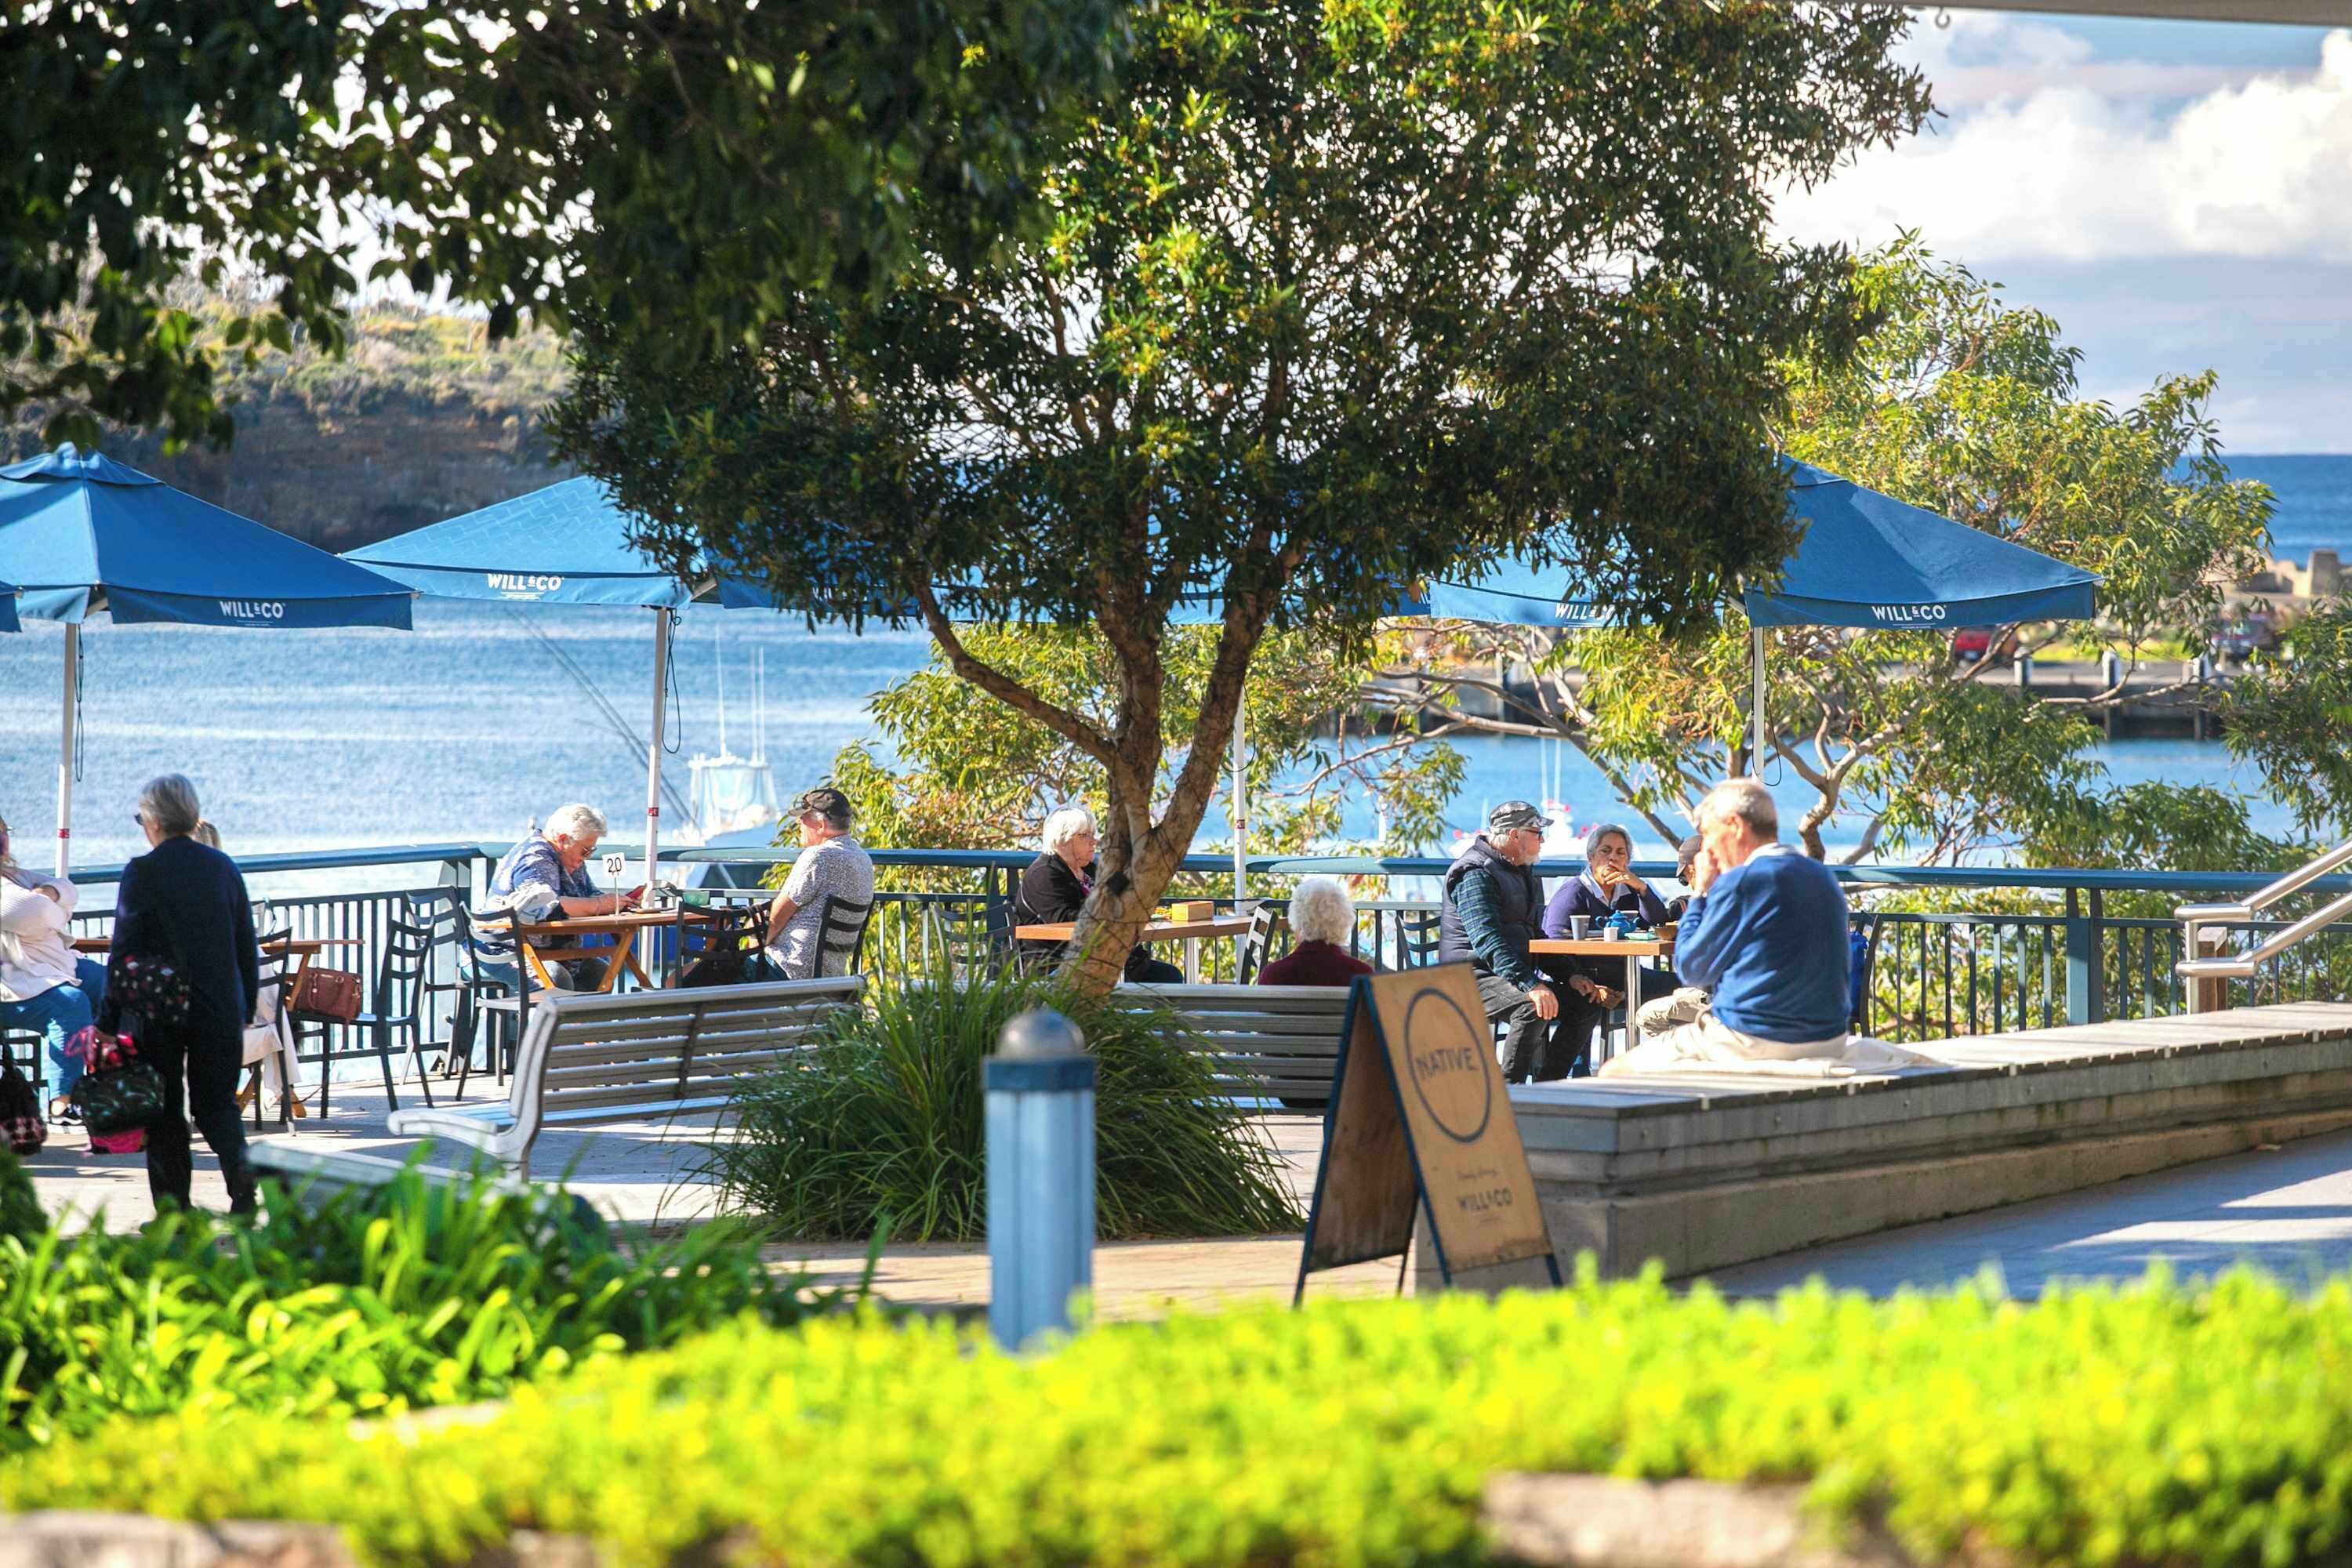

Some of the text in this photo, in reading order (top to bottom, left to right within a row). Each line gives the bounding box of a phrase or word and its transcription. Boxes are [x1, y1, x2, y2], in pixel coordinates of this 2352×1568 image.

[488, 573, 562, 591] WILL&CO
[220, 601, 284, 619] WILL&CO
[1871, 604, 1946, 621] WILL&CO
[607, 857, 622, 873] 20
[1416, 1047, 1479, 1077] NATIVE
